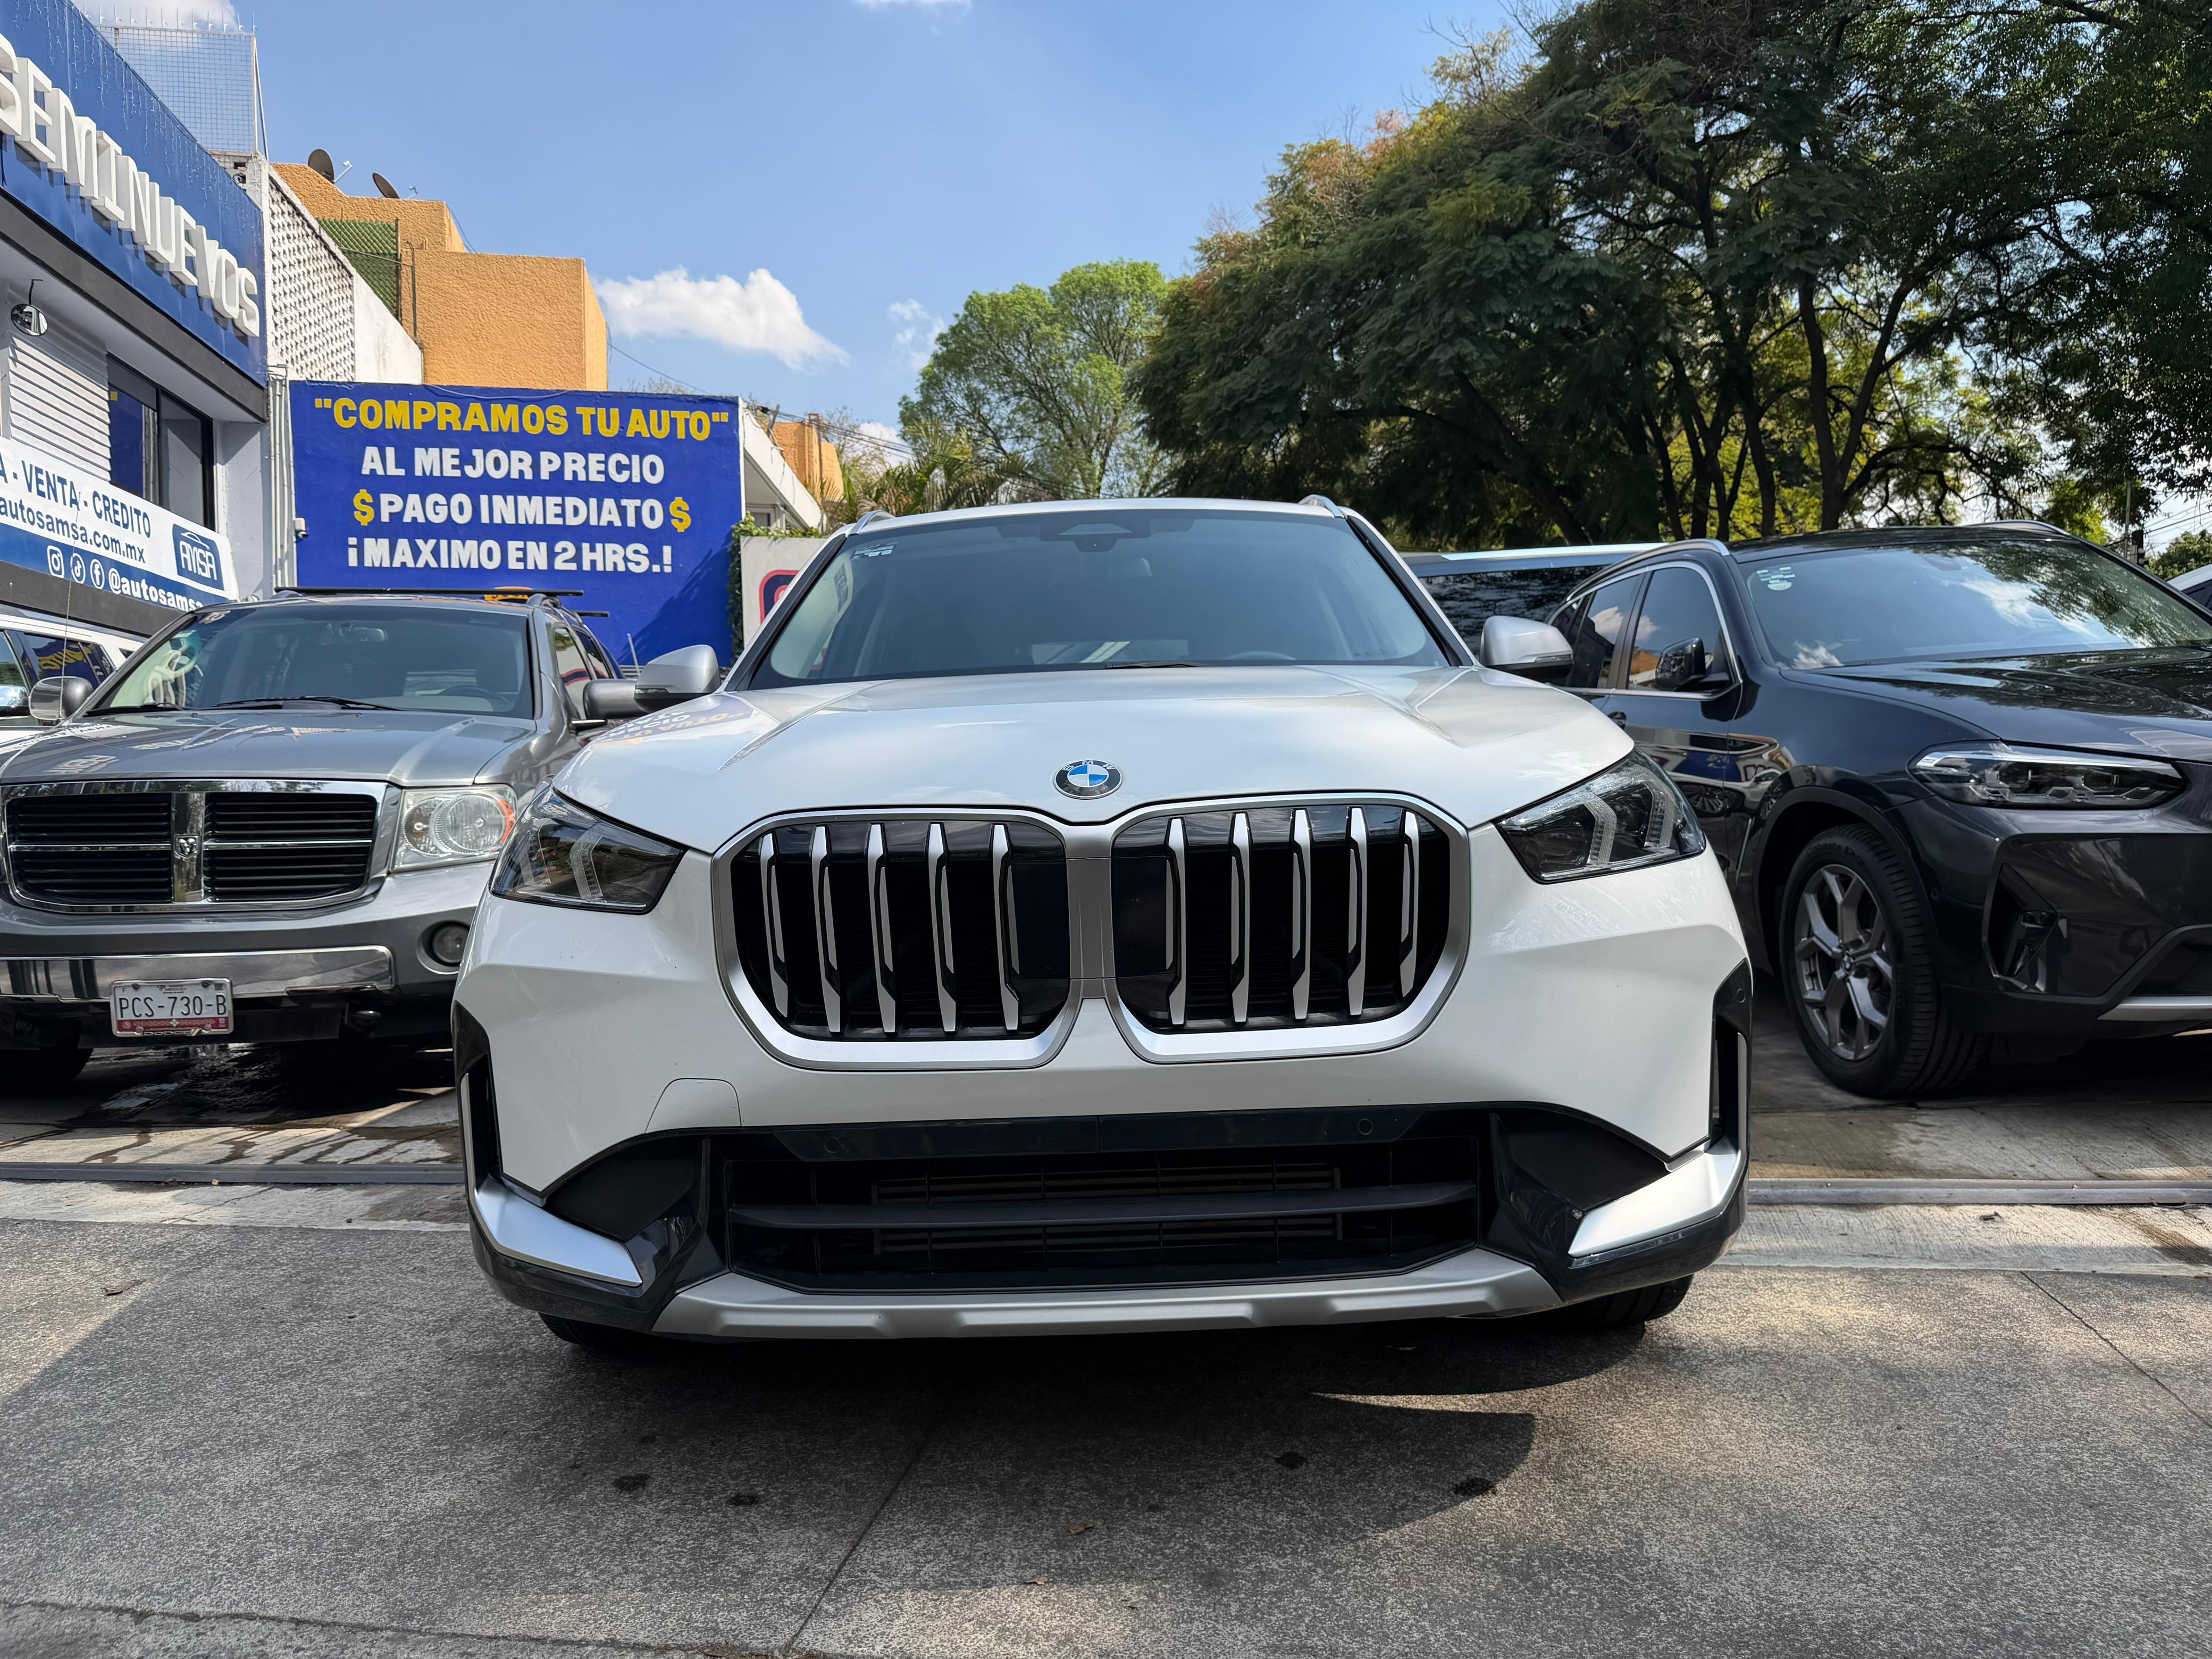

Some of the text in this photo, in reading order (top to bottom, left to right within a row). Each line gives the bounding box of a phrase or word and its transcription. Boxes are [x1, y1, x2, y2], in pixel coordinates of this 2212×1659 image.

[0, 33, 259, 338] SEMINUEVOS
[315, 398, 728, 441] "COMPRAMOS TU AUTO"
[361, 446, 664, 484] AL MEJOR PRECIO
[21, 460, 80, 511] VENTA
[92, 490, 151, 539] CREDITO
[380, 493, 473, 524] PAGO
[480, 495, 664, 529] INMEDIATO
[507, 540, 548, 570] EN
[554, 540, 577, 571] 2
[582, 542, 672, 573] HRS.!
[1062, 760, 1115, 772] BMW
[119, 995, 226, 1018] PCS-730-B
